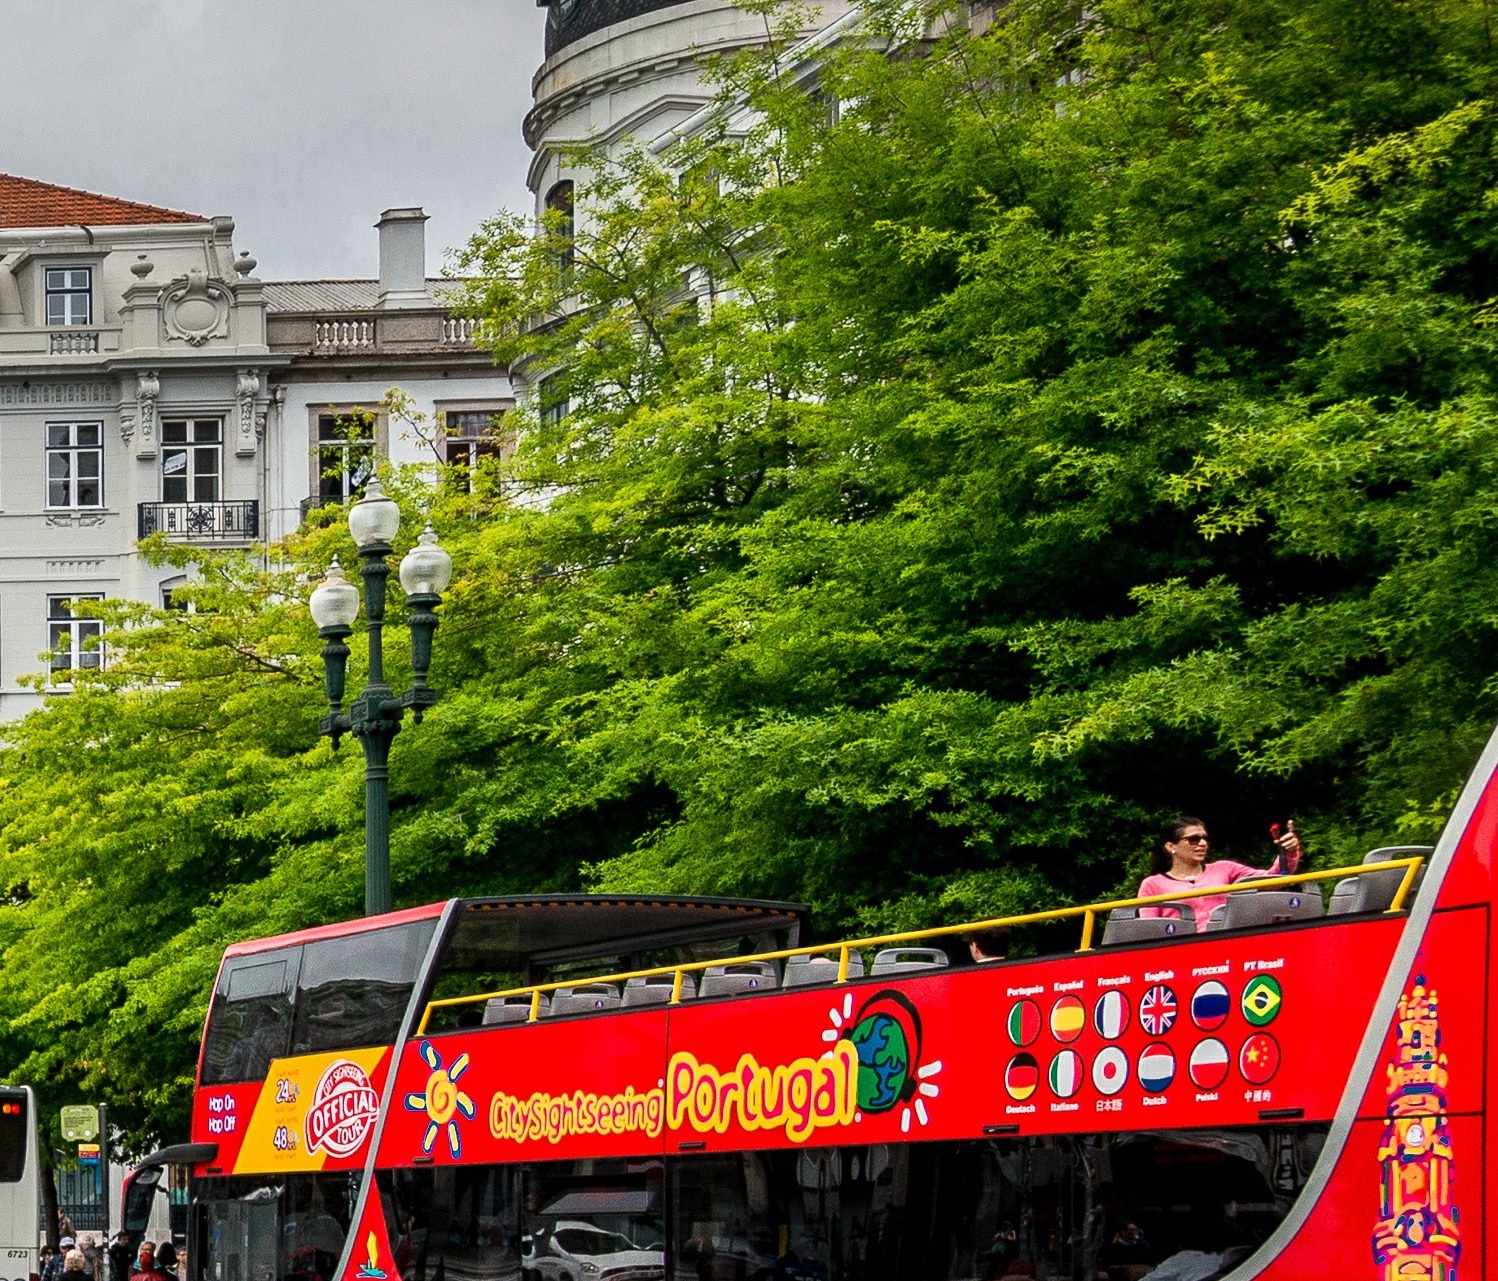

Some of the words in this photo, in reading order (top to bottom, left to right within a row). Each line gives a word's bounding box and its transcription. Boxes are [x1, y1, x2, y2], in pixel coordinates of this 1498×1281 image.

[1144, 970, 1175, 982] English
[1007, 984, 1045, 997] Português
[1053, 980, 1085, 992] Español
[667, 1039, 859, 1144] Portugal
[208, 1096, 223, 1114] Hop
[224, 1093, 236, 1112] On
[1006, 1103, 1036, 1115] Deutsch
[1143, 1095, 1167, 1107] Dutch
[312, 1091, 377, 1138] OFFICIAL
[208, 1117, 223, 1134] Hop
[224, 1115, 236, 1132] Off
[337, 1120, 365, 1145] TOUR
[273, 1126, 288, 1151] 48
[7, 1250, 28, 1259] 6723
